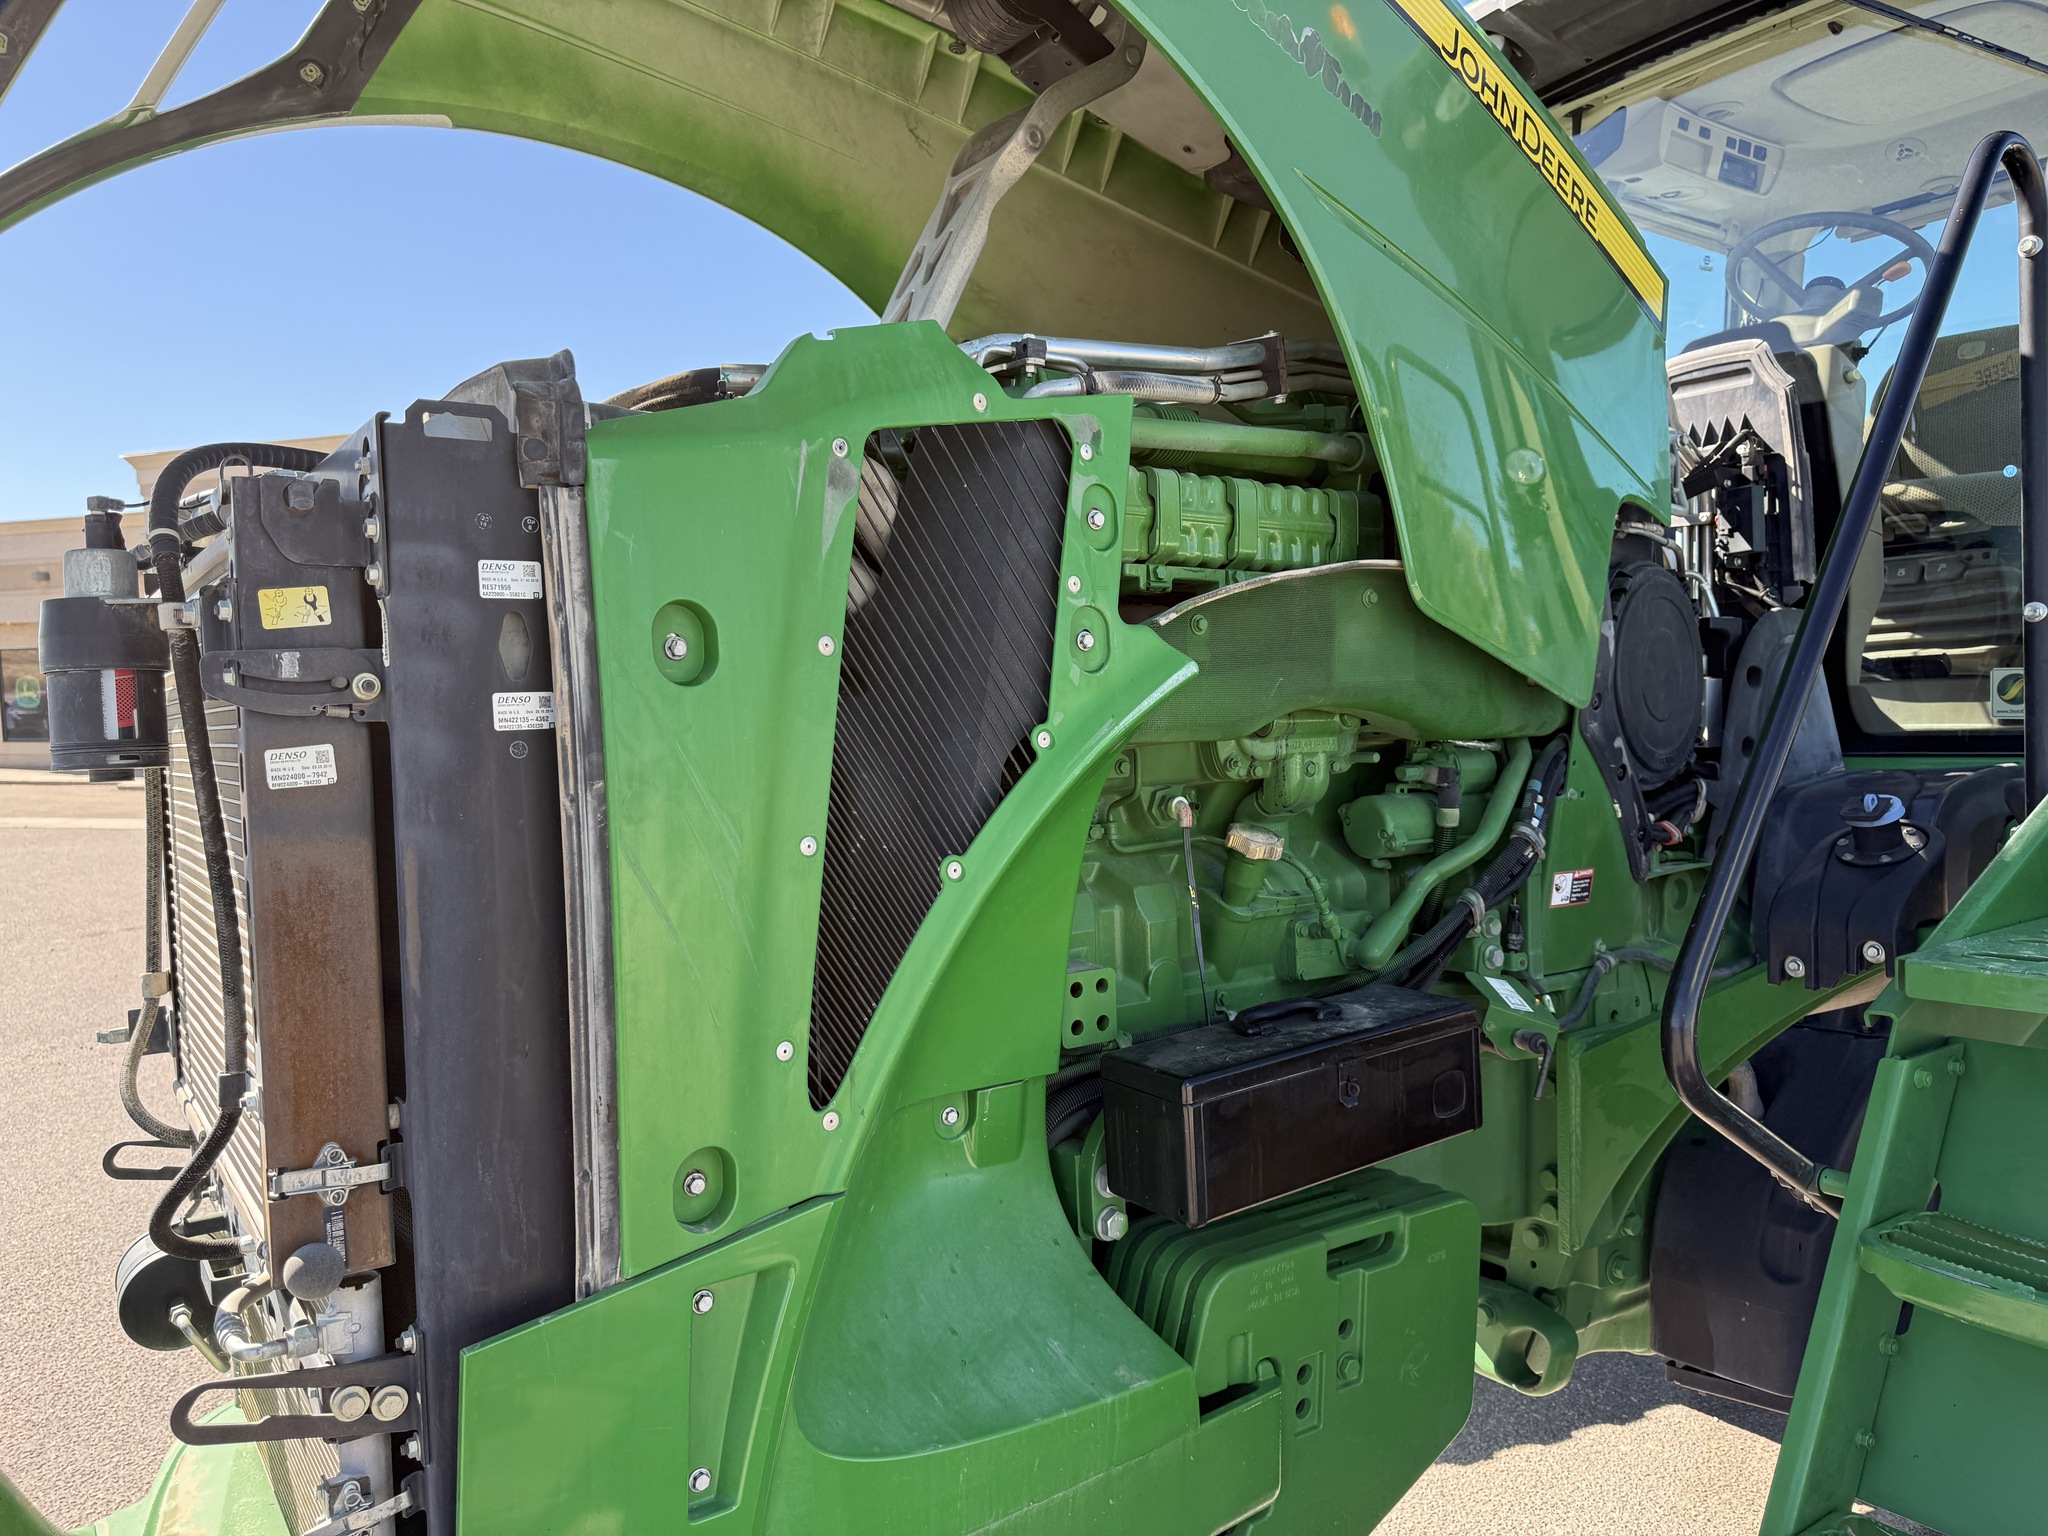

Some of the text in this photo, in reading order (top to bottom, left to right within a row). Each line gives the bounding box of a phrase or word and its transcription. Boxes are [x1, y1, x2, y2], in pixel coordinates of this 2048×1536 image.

[481, 562, 516, 571] DENSO
[482, 583, 512, 591] RE571959
[497, 695, 531, 704] DENSO
[269, 750, 307, 761] DENSO
[271, 771, 328, 782] MN024000-7942
